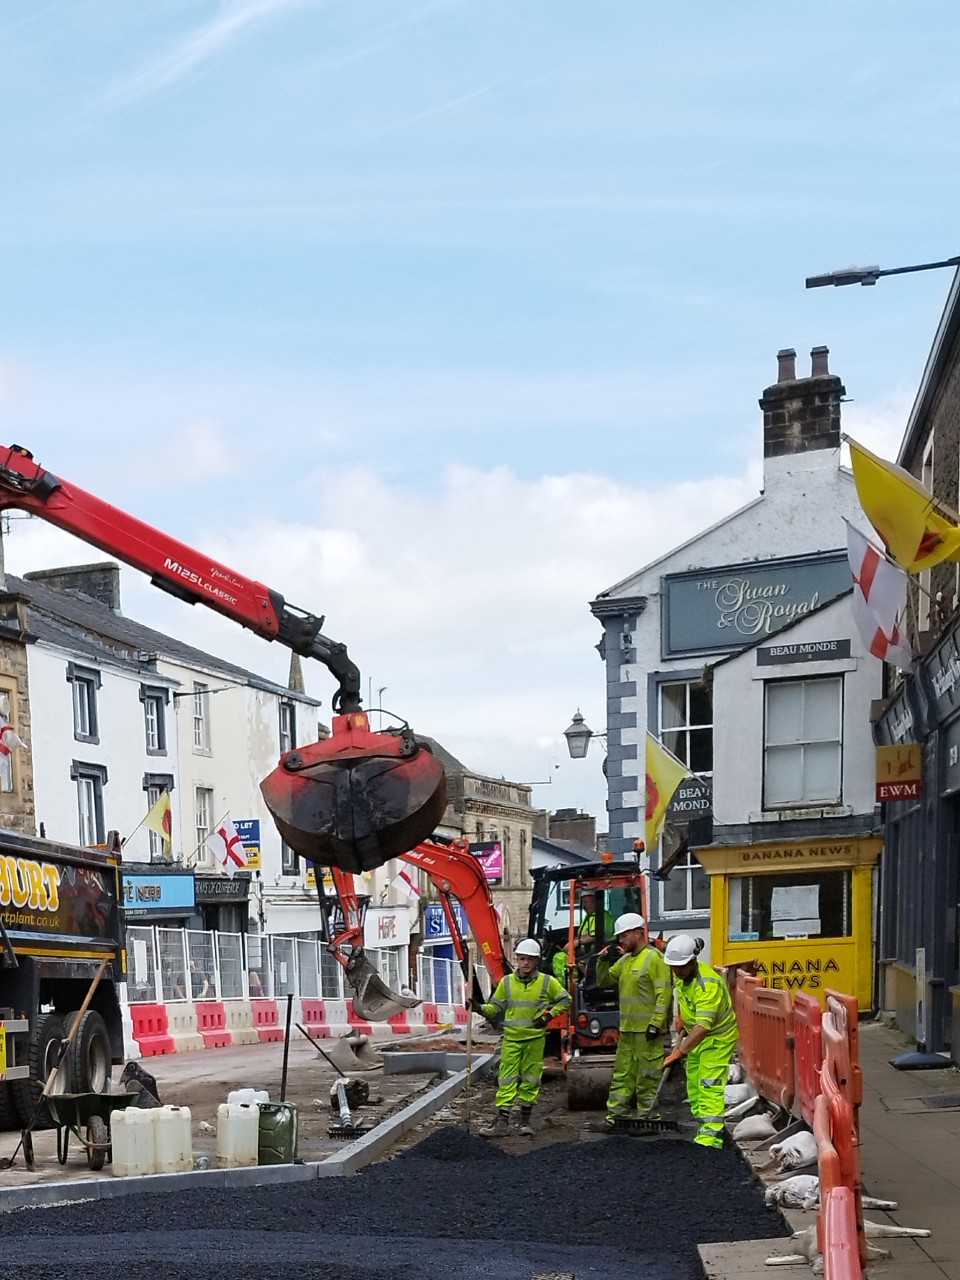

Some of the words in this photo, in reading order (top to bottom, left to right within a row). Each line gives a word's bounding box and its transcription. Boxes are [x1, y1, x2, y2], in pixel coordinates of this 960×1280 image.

[696, 580, 720, 592] THE
[714, 577, 791, 613] Swan
[717, 611, 736, 629] &
[734, 591, 823, 635] Royal
[769, 645, 797, 656] BEAU
[800, 641, 838, 654] MONDE
[879, 783, 918, 798] EWM
[673, 799, 710, 812] MOND
[240, 821, 253, 830] LET
[742, 849, 804, 862] BANANA
[809, 845, 852, 856] NEWS
[755, 957, 840, 975] ANANA
